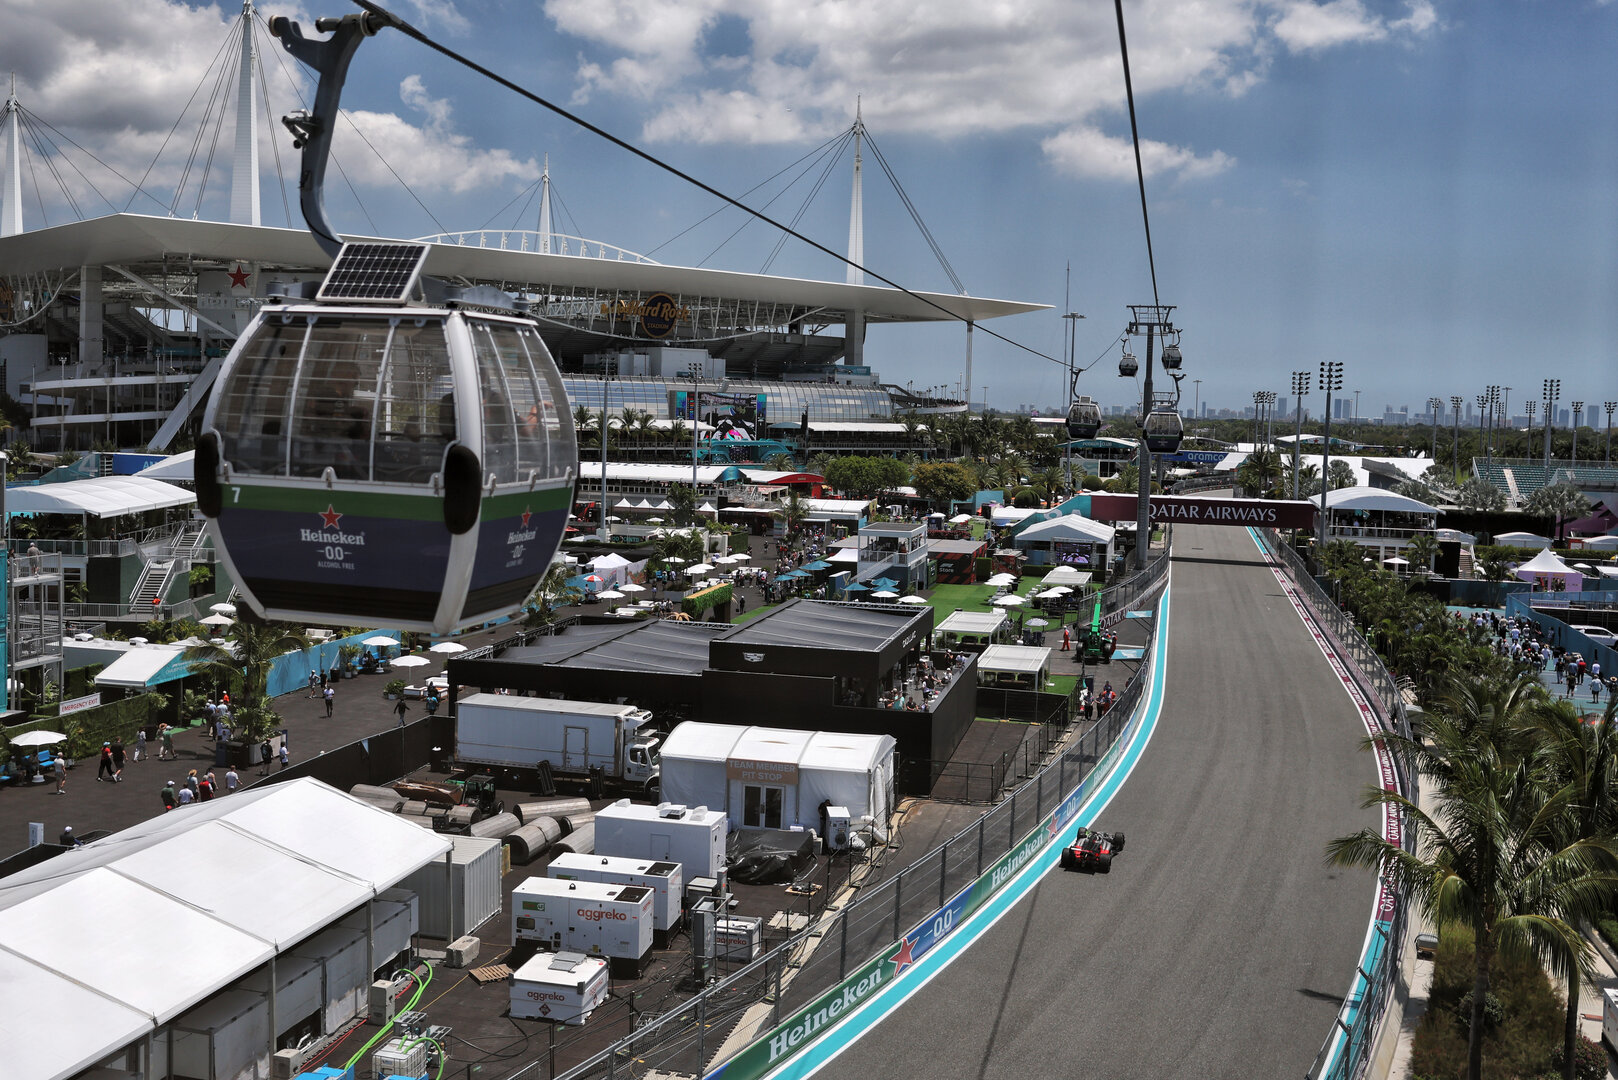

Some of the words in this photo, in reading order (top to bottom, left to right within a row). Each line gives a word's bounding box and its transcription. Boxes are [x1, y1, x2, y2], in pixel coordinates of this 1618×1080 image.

[661, 302, 689, 322] Rock
[1187, 452, 1225, 461] aramco
[231, 486, 241, 503] 7
[1149, 503, 1200, 519] QATAR
[1203, 506, 1277, 522] AIRWAYS
[300, 528, 366, 545] Heineken
[317, 561, 341, 569] ALCOHOL
[61, 701, 88, 713] EMERGENCY
[88, 698, 98, 706] EXIT
[729, 760, 754, 769] TEAM
[756, 762, 796, 773] MEMBER
[743, 771, 756, 779] PIT
[757, 772, 782, 781] STOP
[1388, 819, 1399, 840] QATAR
[990, 832, 1044, 890] Heineken
[577, 908, 627, 921] aggreko
[527, 991, 565, 1001] aggreko
[768, 967, 883, 1063] Heineken
